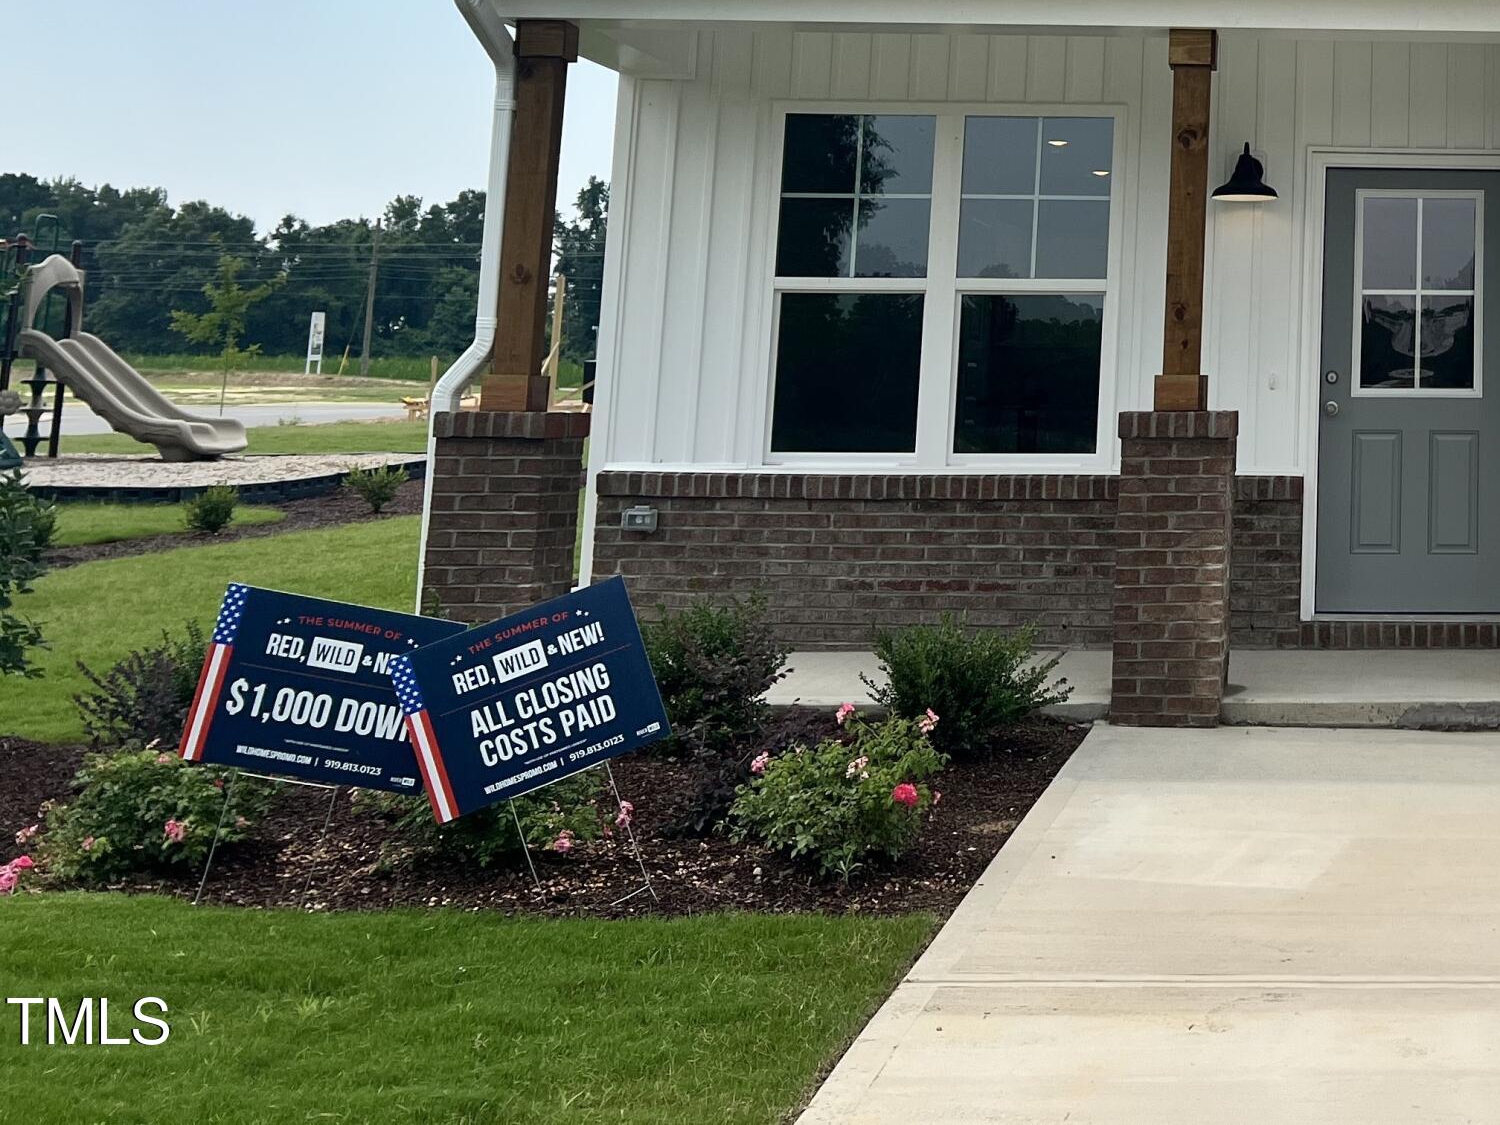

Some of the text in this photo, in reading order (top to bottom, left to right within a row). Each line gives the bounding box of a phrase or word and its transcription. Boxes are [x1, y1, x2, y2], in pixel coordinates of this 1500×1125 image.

[265, 633, 306, 663] RED,
[315, 643, 357, 666] WILD
[361, 655, 373, 667] &
[298, 615, 402, 641] THE SUMMER OF
[468, 611, 570, 655] THE SUMMER OF
[451, 621, 605, 695] RED, WILD & NEW!
[226, 678, 333, 729] $1,000
[470, 662, 611, 738] ALL CLOSING
[479, 717, 557, 767] COSTS
[559, 694, 617, 738] PAID
[569, 733, 625, 762] 919.813.0123
[324, 759, 382, 776] 919.813.0123
